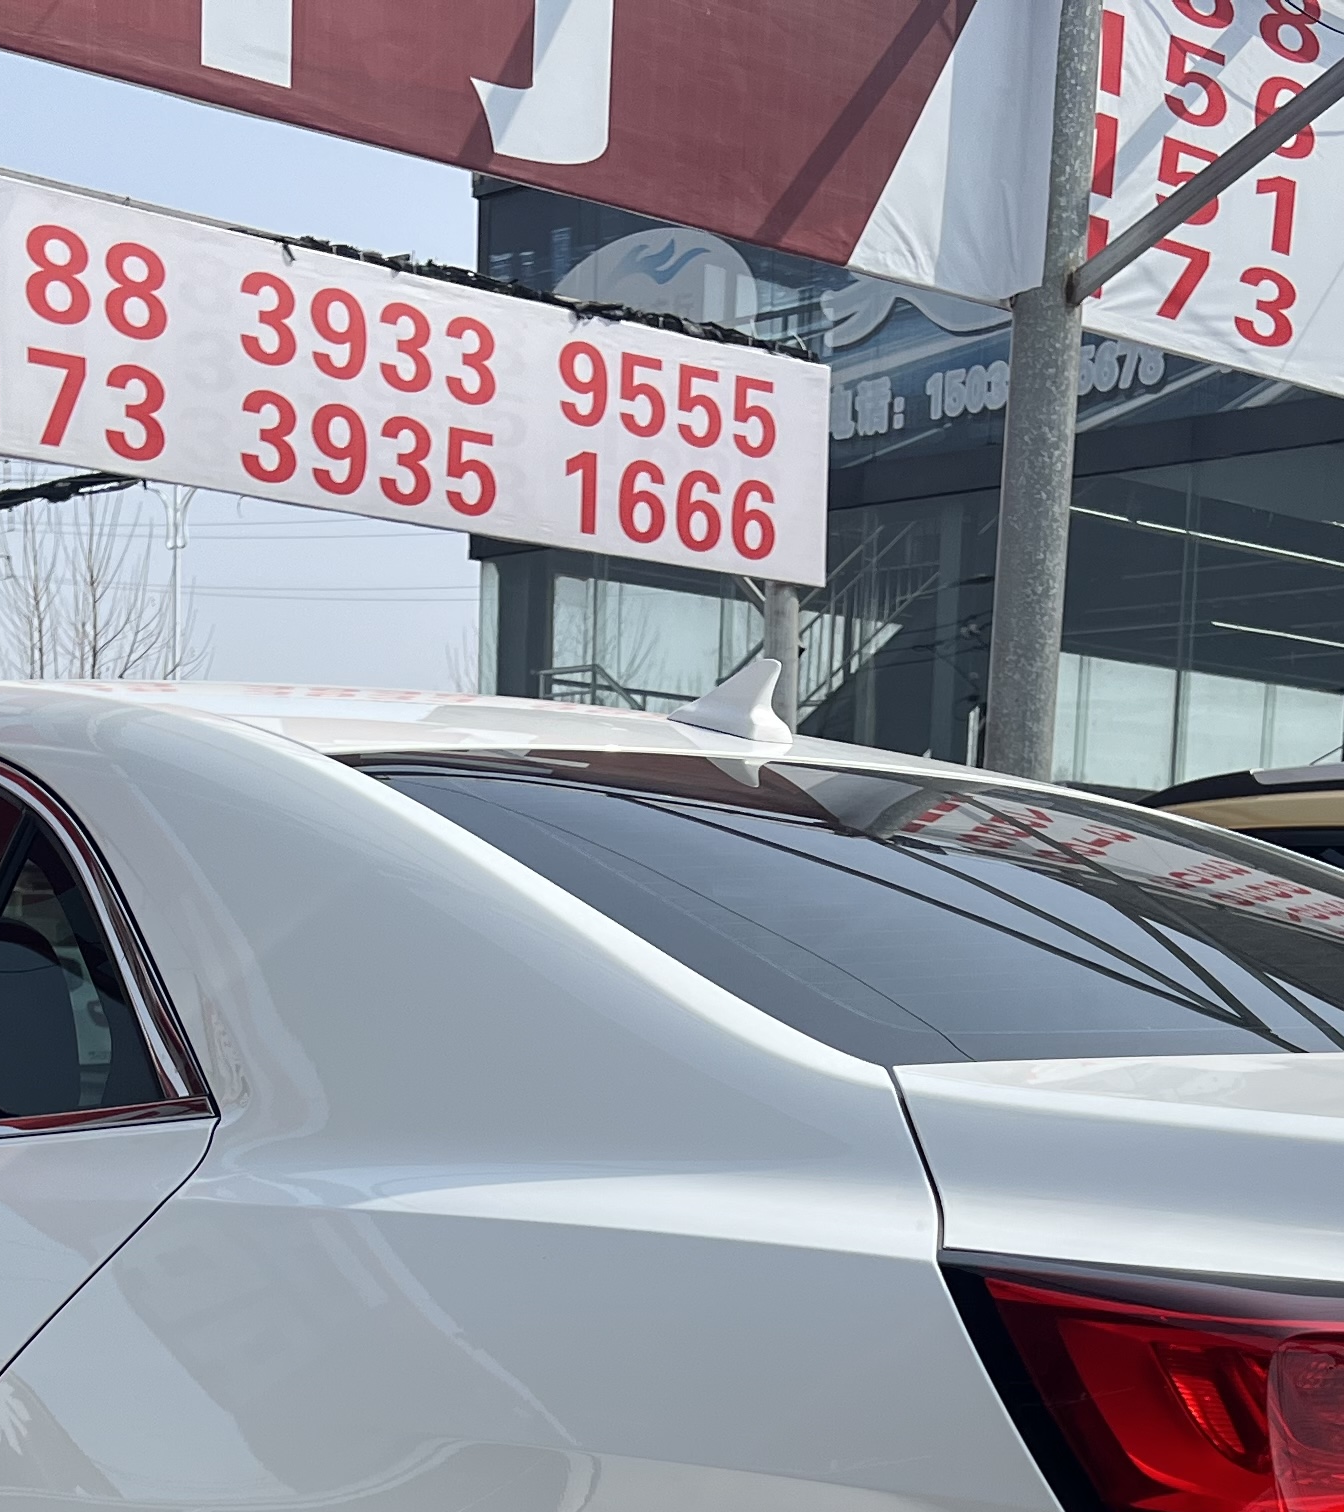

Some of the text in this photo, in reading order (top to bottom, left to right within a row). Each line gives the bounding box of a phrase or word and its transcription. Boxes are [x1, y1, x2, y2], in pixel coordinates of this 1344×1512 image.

[241, 271, 497, 406] 3933
[559, 341, 777, 459] 9555
[924, 341, 1166, 420] 15035678
[241, 389, 497, 517] 3935
[566, 451, 776, 560] 1666
